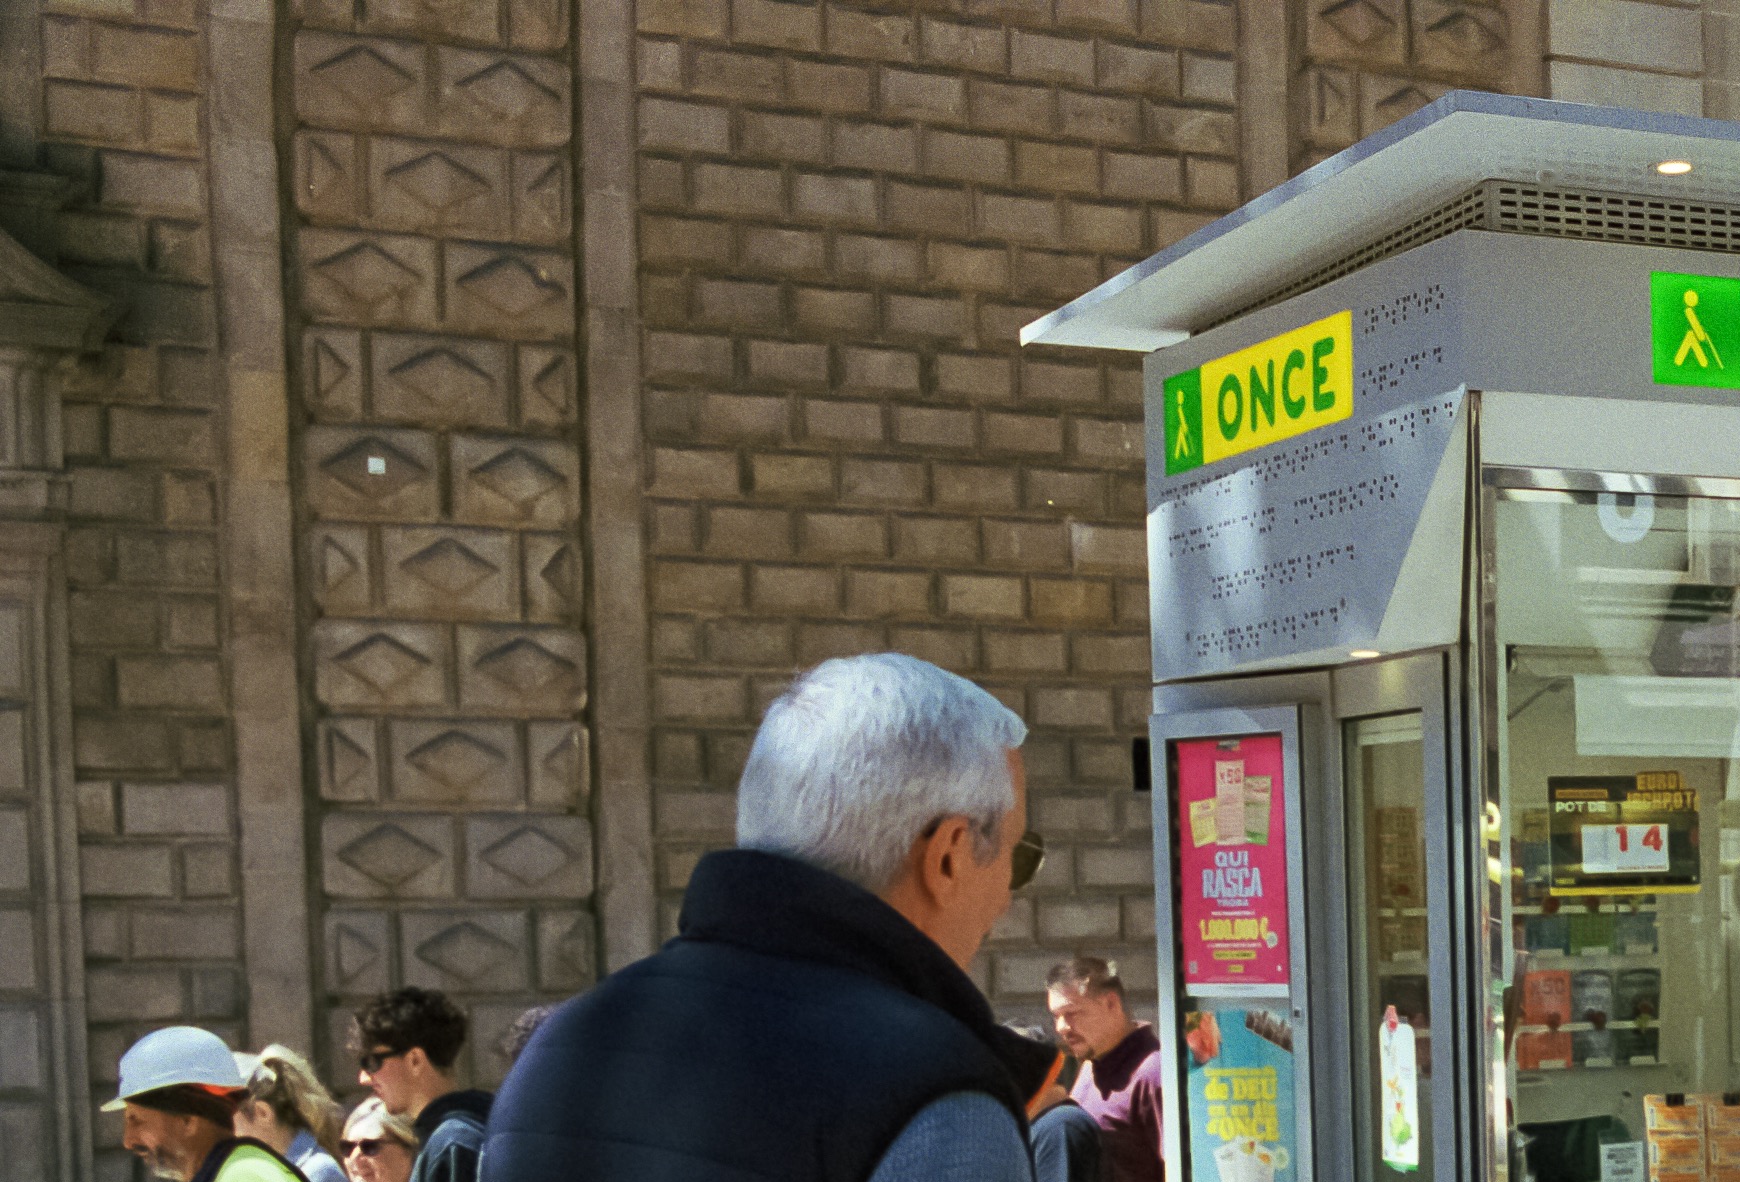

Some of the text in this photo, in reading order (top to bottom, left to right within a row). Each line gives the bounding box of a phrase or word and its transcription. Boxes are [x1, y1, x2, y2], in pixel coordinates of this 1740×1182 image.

[1217, 336, 1336, 442] ONCE
[1555, 801, 1585, 813] POT
[1214, 850, 1249, 867] QUI
[1202, 867, 1263, 898] RASCA
[1232, 1077, 1278, 1101] DEU
